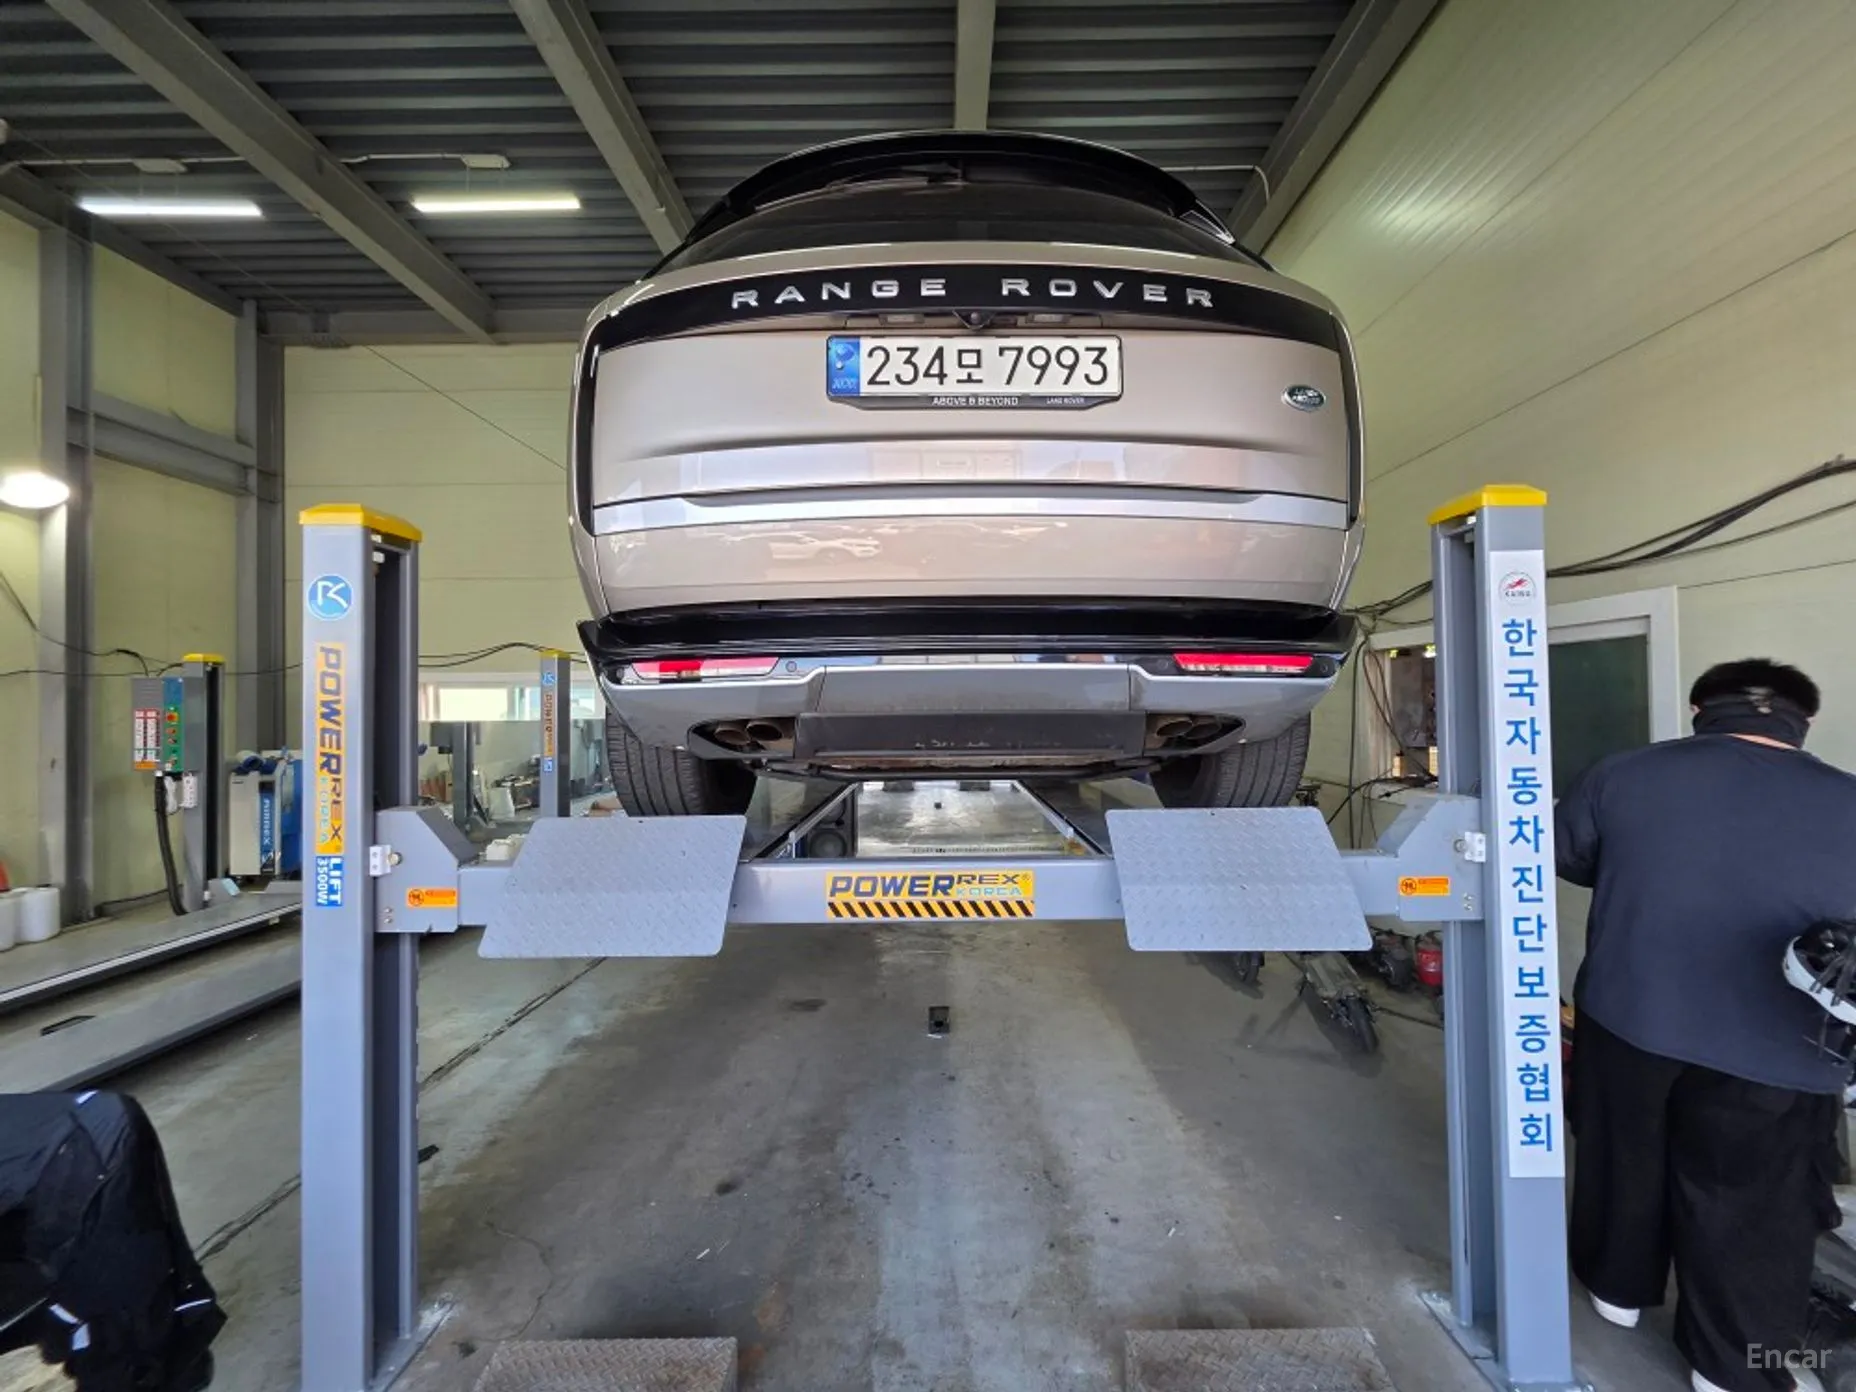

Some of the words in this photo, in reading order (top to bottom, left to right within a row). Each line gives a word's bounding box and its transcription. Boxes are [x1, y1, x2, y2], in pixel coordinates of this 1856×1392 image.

[731, 278, 946, 309] RANGE
[1001, 278, 1213, 307] ROVER
[867, 345, 983, 386] 234모
[998, 345, 1109, 386] 7993
[932, 396, 966, 406] ABOVE
[978, 396, 1019, 406] BEYOND
[317, 858, 328, 904] 3500W
[328, 857, 341, 904] LIFT
